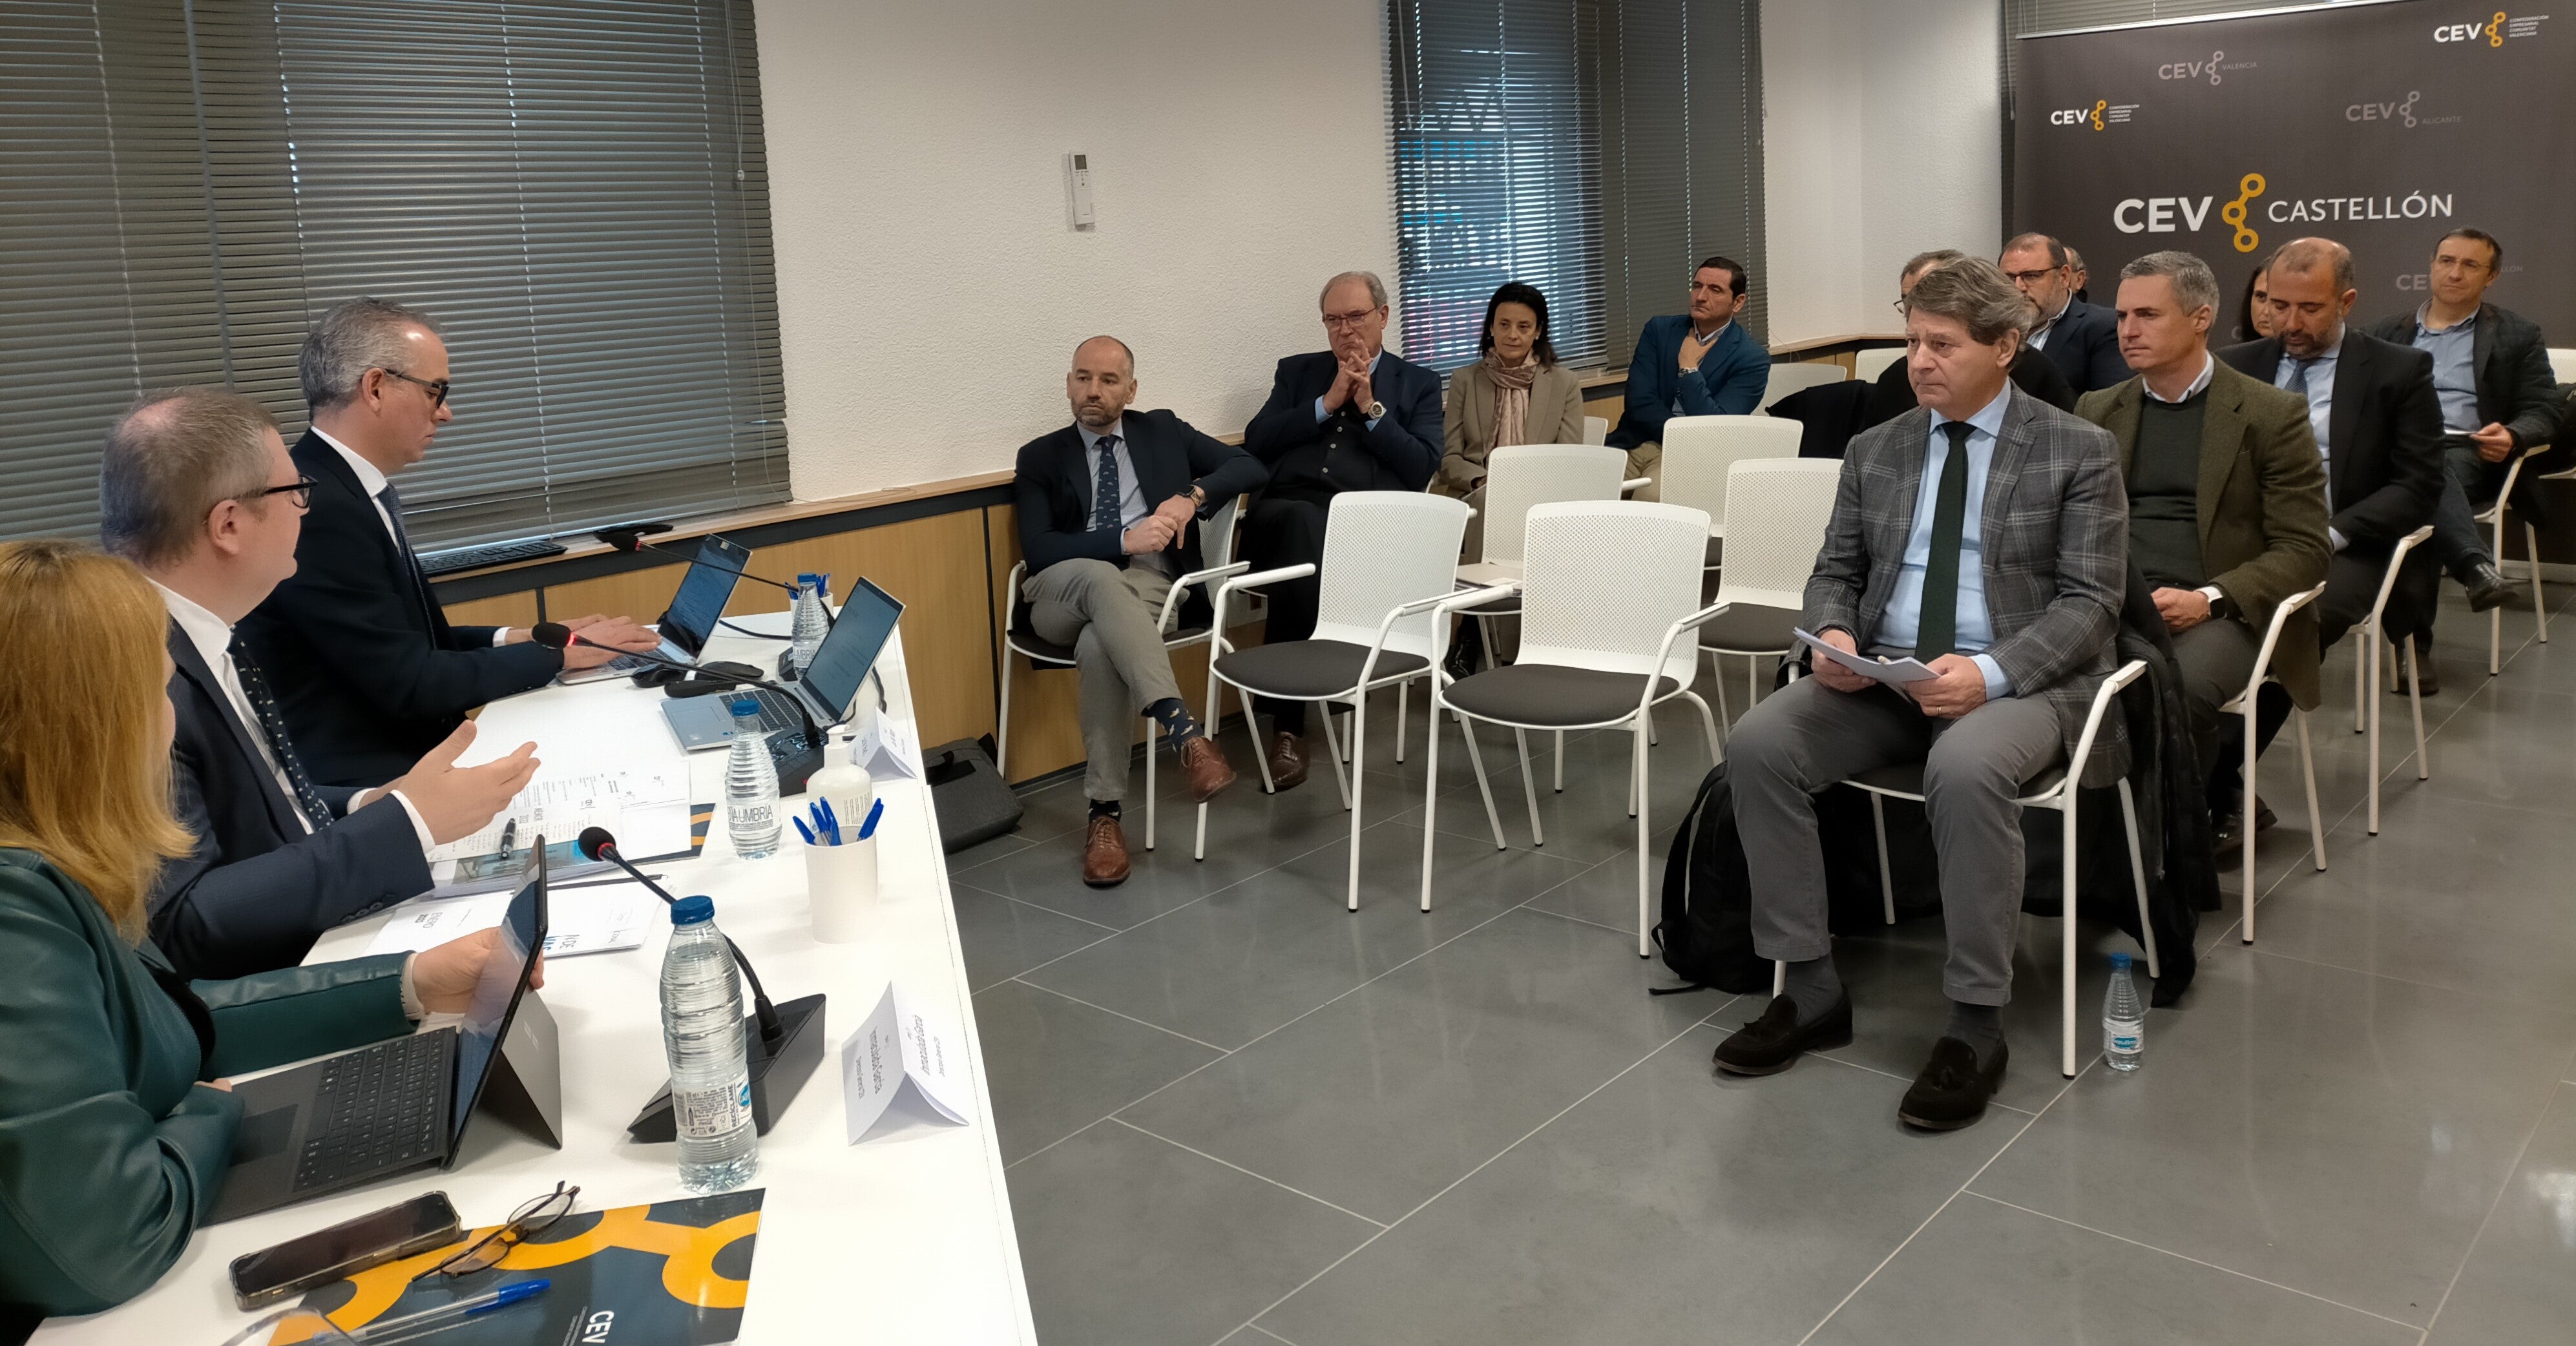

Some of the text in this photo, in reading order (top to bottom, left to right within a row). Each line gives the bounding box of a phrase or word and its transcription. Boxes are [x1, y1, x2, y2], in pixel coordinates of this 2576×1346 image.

[2434, 23, 2482, 43] CEV
[2159, 61, 2257, 79] CEV VALENCIA
[2051, 109, 2088, 125] CEV
[2345, 102, 2462, 125] CEV ALICANTE
[2113, 190, 2453, 234] CEV CASTELLÓN
[2396, 274, 2431, 291] CE
[582, 1310, 614, 1343] CEV
